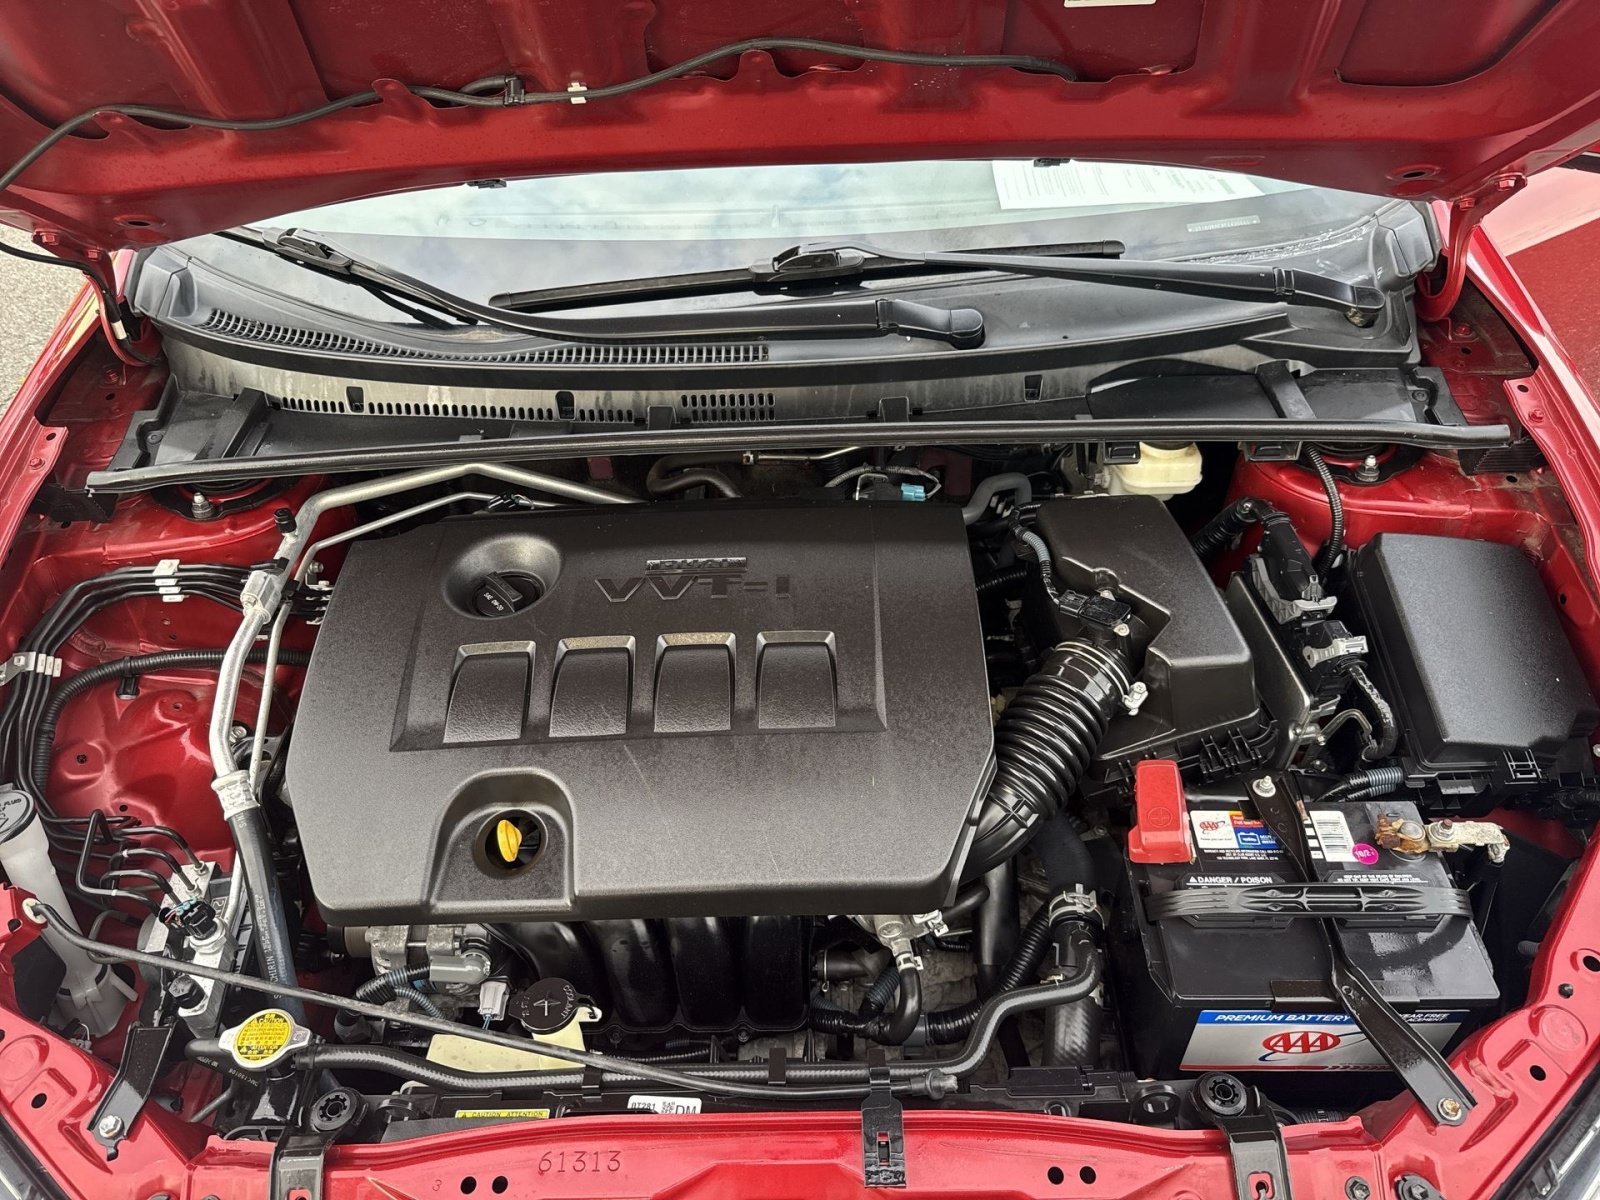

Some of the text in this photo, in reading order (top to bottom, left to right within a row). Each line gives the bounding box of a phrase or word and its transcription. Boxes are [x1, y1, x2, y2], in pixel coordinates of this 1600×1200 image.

[1197, 876, 1233, 884] DANGER
[1241, 876, 1273, 884] POISON
[561, 984, 575, 1018] COOLANT
[1284, 1014, 1352, 1022] BATTERY
[1263, 1031, 1340, 1054] AAA
[538, 1151, 622, 1173] 61313
[432, 1179, 442, 1191] 3
